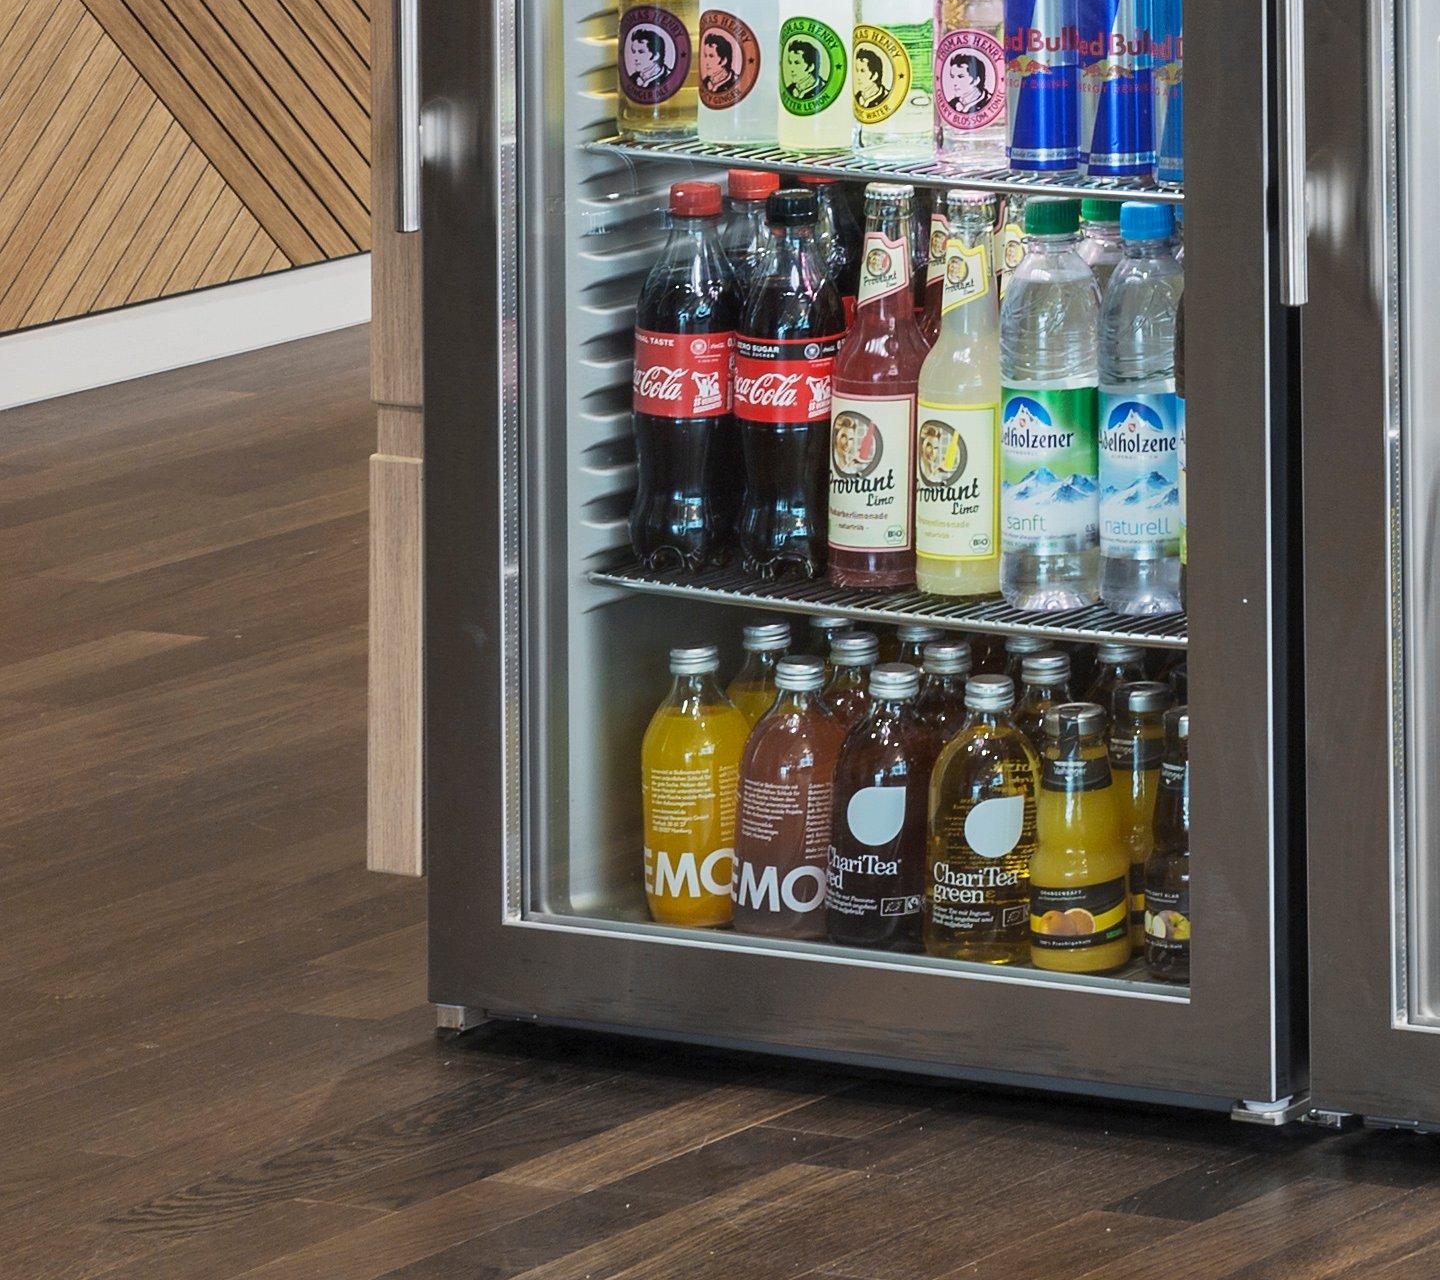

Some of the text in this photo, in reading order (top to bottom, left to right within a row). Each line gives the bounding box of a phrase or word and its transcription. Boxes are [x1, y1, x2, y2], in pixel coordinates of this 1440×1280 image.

[1027, 27, 1076, 52] Bull
[937, 35, 1004, 63] THOMAS HENRY
[952, 112, 989, 125] BLOSSOM
[650, 338, 674, 347] TASTE
[752, 345, 779, 354] SUGAR
[1007, 514, 1046, 532] sanft
[1105, 518, 1172, 535] naturell
[933, 861, 1019, 888] ChariTea
[933, 883, 985, 904] green
